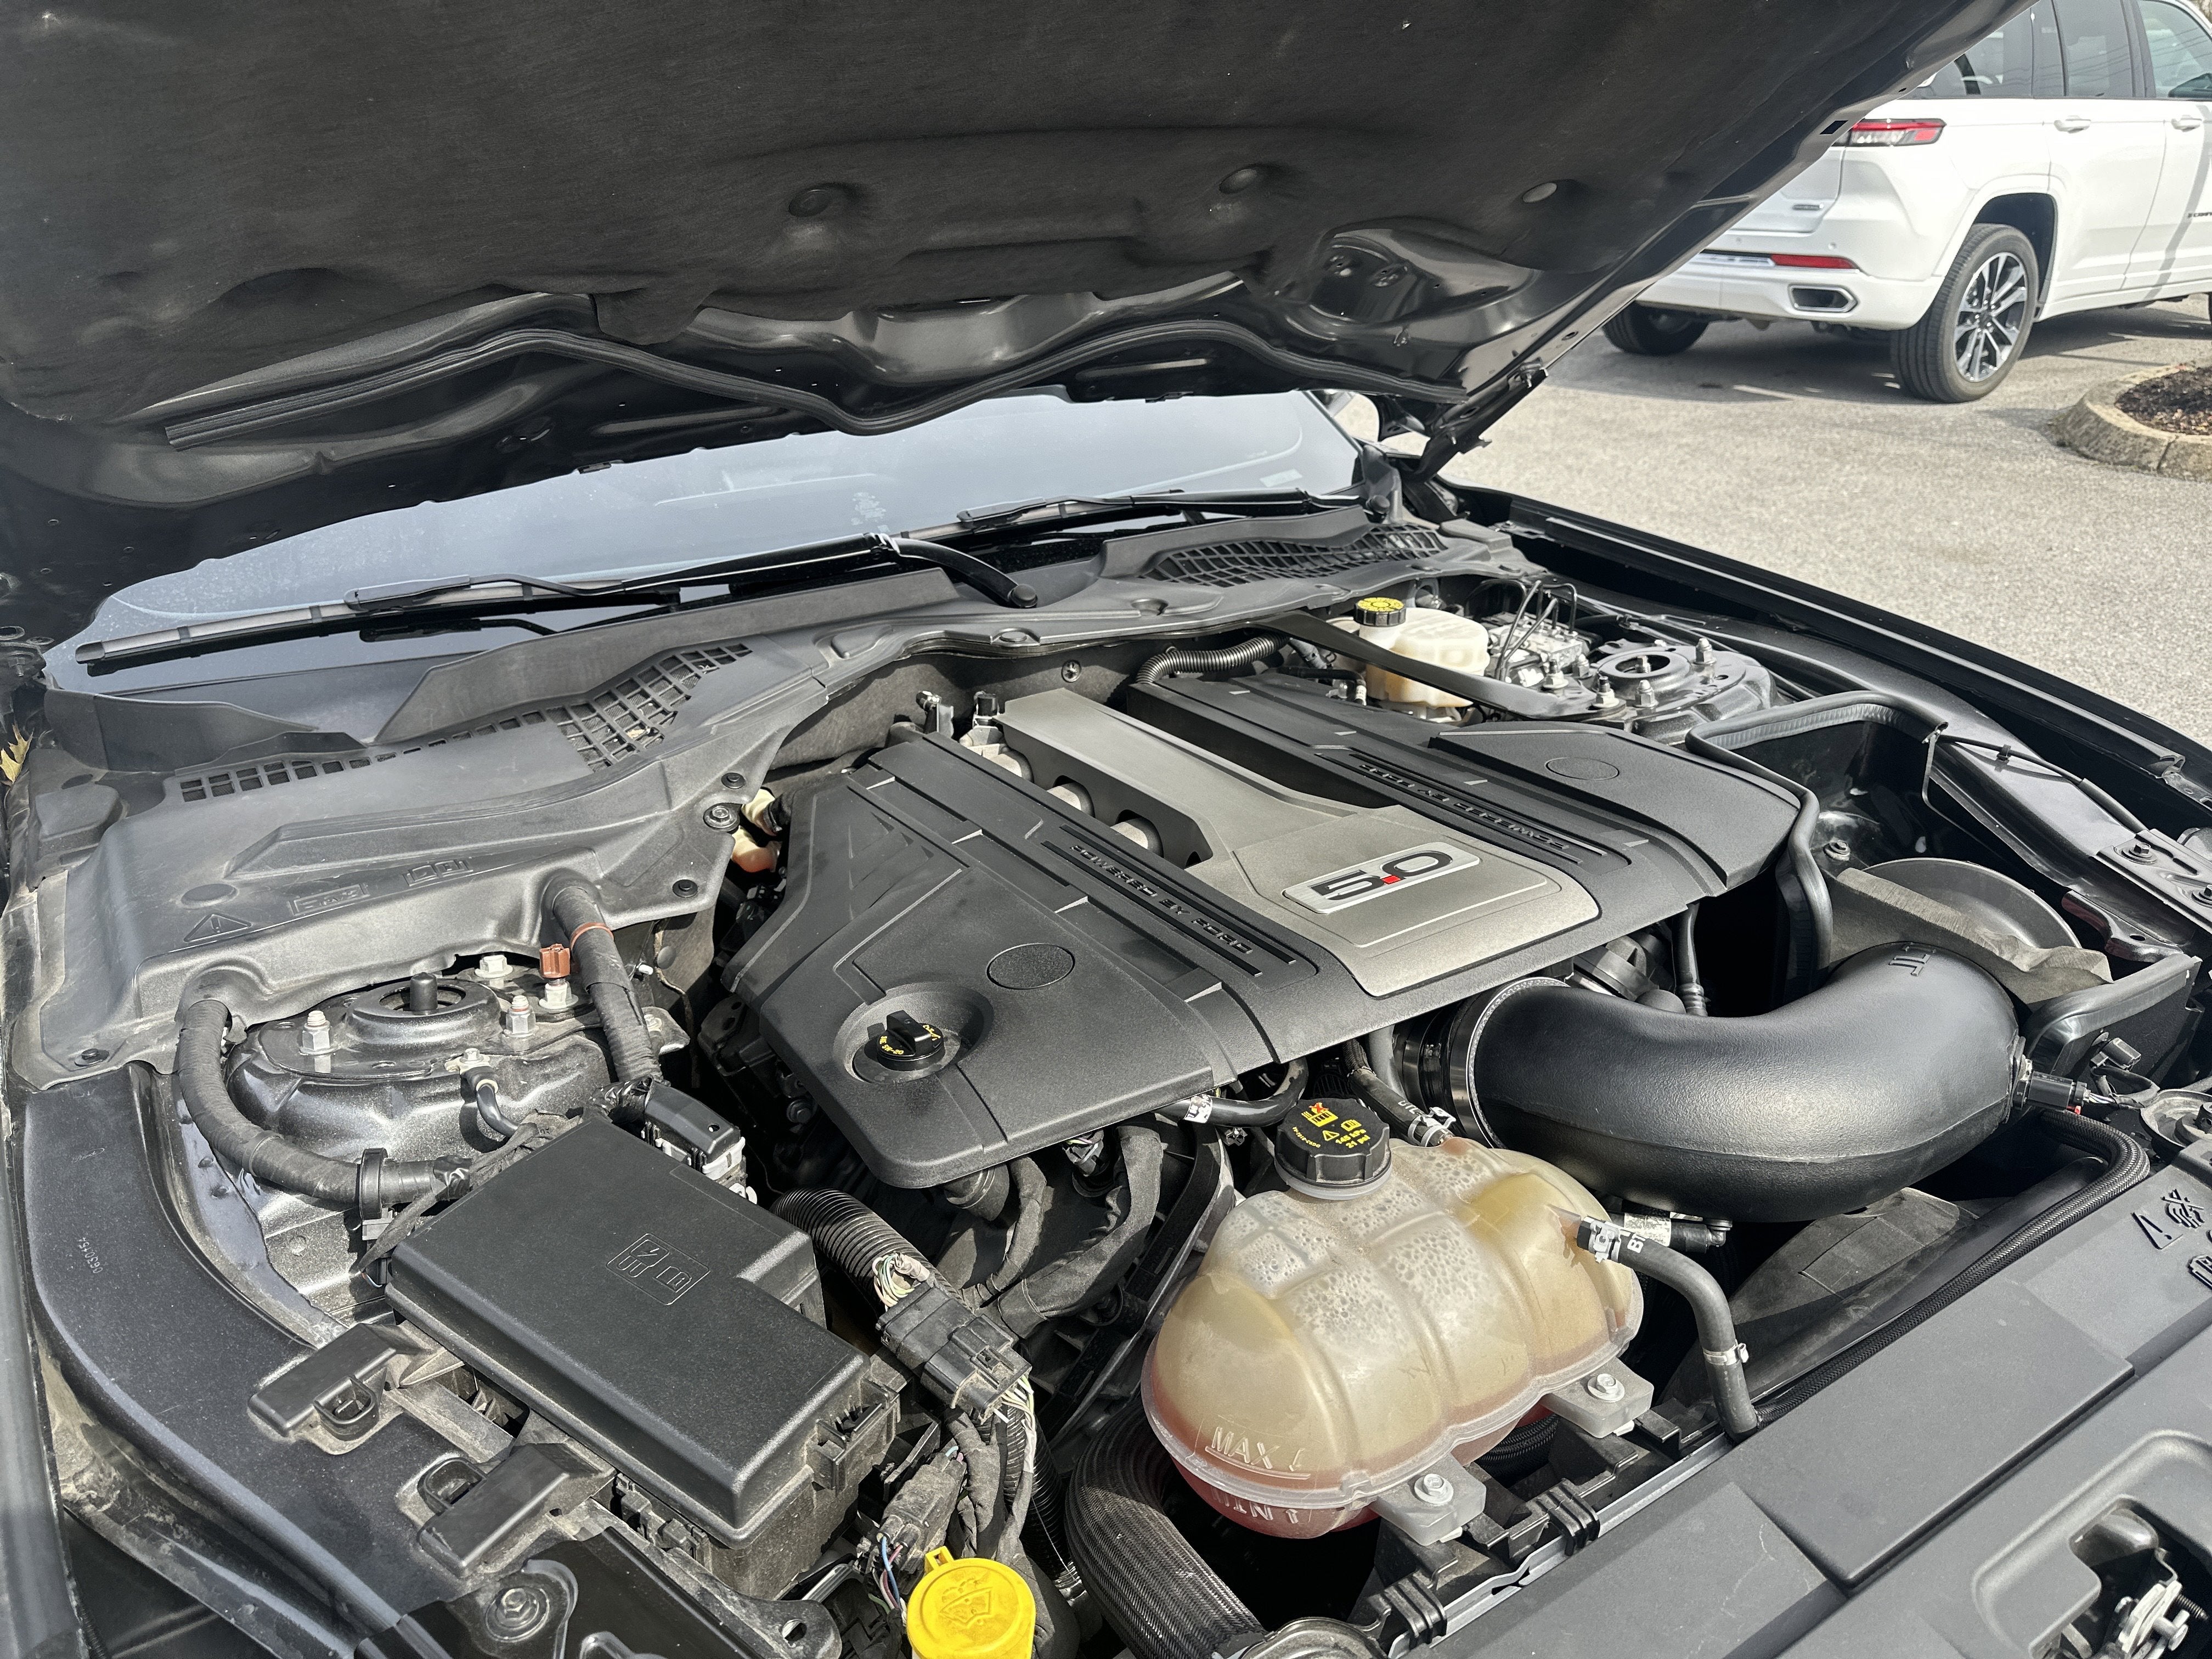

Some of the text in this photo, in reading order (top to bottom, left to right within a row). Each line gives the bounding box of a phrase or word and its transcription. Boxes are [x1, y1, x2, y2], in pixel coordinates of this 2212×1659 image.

[1359, 764, 1570, 850] POWERED BY FORD
[1309, 850, 1454, 901] 5.0
[1069, 845, 1254, 955] POWERED BY FORD
[882, 1044, 904, 1055] 5W-20
[1335, 1135, 1351, 1144] 145
[1345, 1141, 1358, 1149] 21
[1211, 1426, 1280, 1469] MAX
